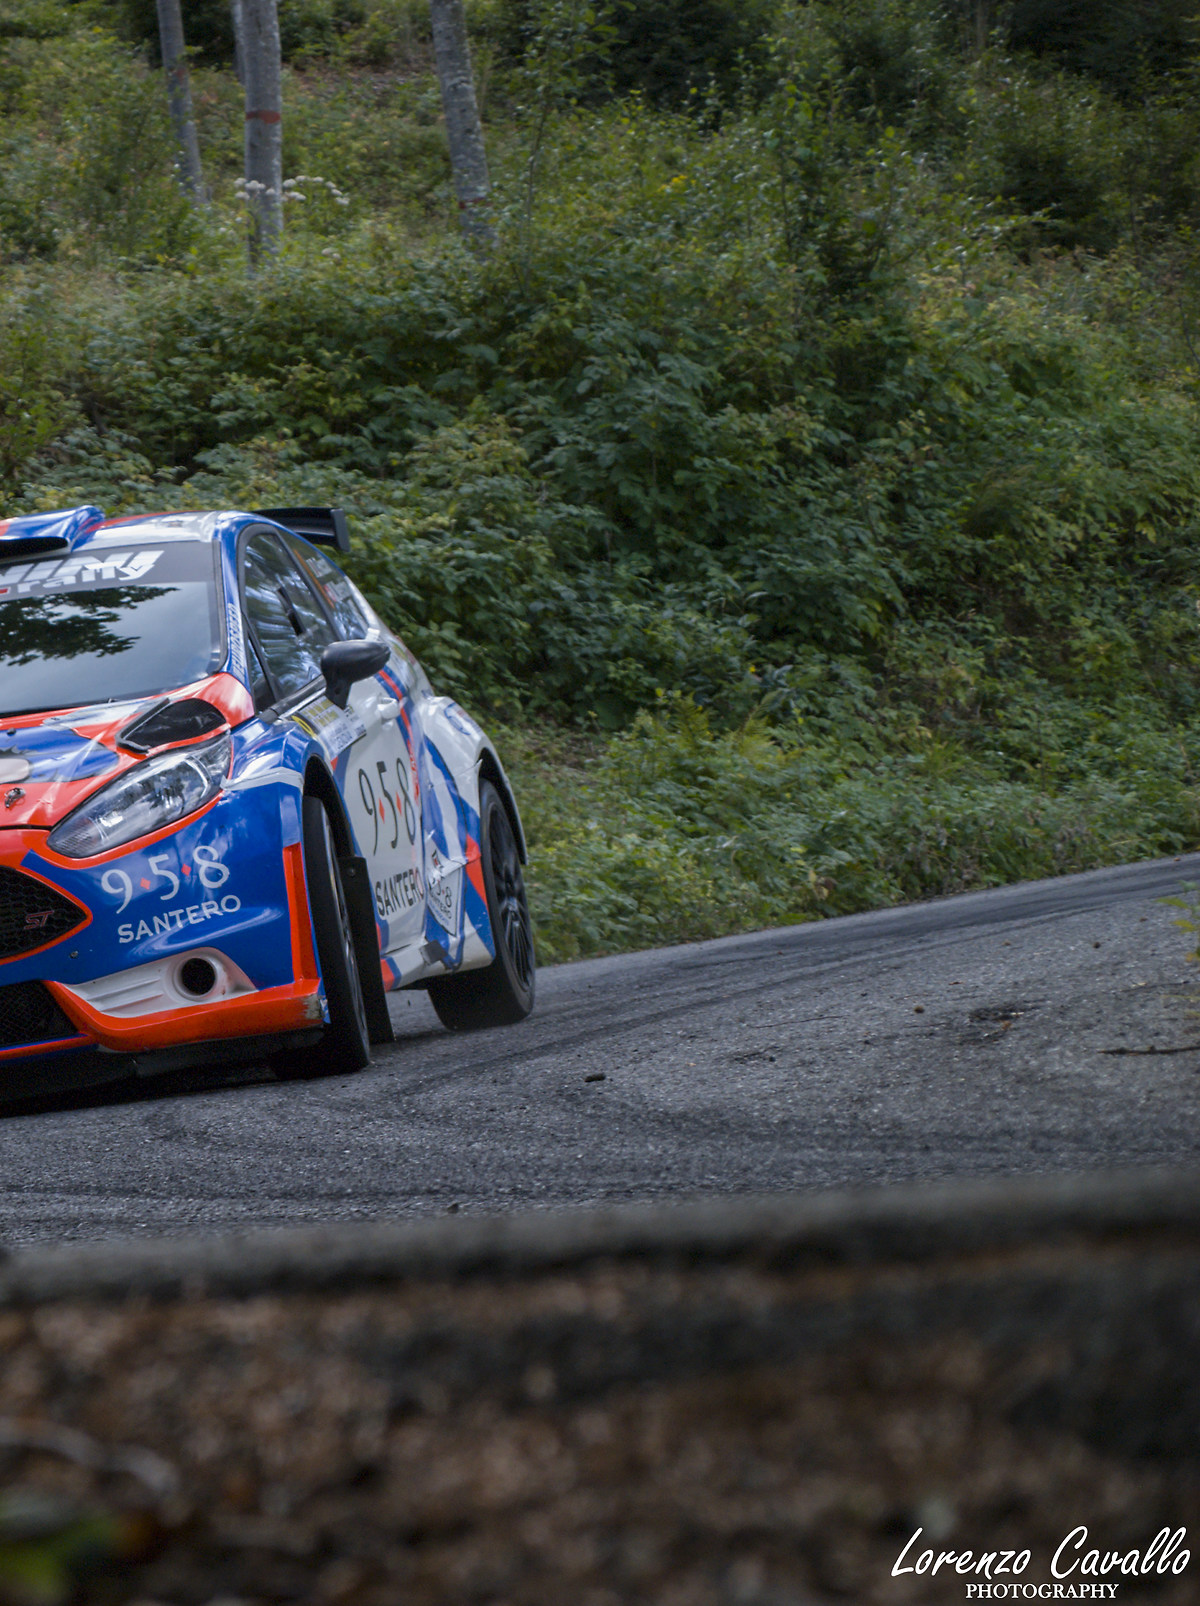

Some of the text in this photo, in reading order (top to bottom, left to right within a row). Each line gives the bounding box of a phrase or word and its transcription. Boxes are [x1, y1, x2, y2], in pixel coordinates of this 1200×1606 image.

[17, 560, 156, 593] rally
[375, 866, 426, 917] SANTERO
[23, 910, 54, 930] ST
[117, 894, 241, 943] SANTERO
